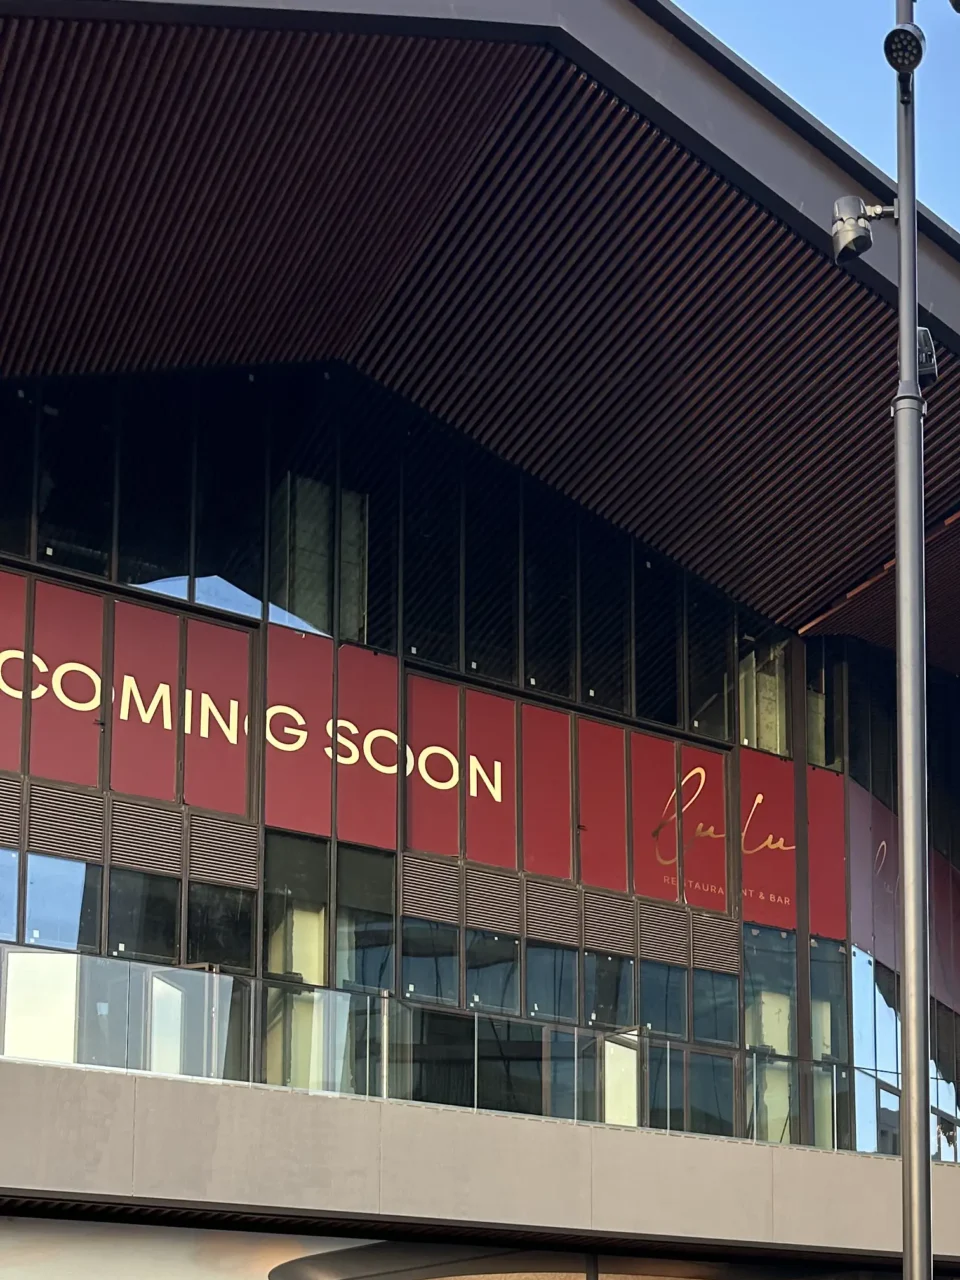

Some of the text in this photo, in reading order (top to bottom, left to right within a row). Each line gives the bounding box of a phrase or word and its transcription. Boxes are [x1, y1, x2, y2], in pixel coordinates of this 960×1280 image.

[0, 649, 502, 803] COMING SOON
[663, 875, 791, 905] RETAURANT & BAR
